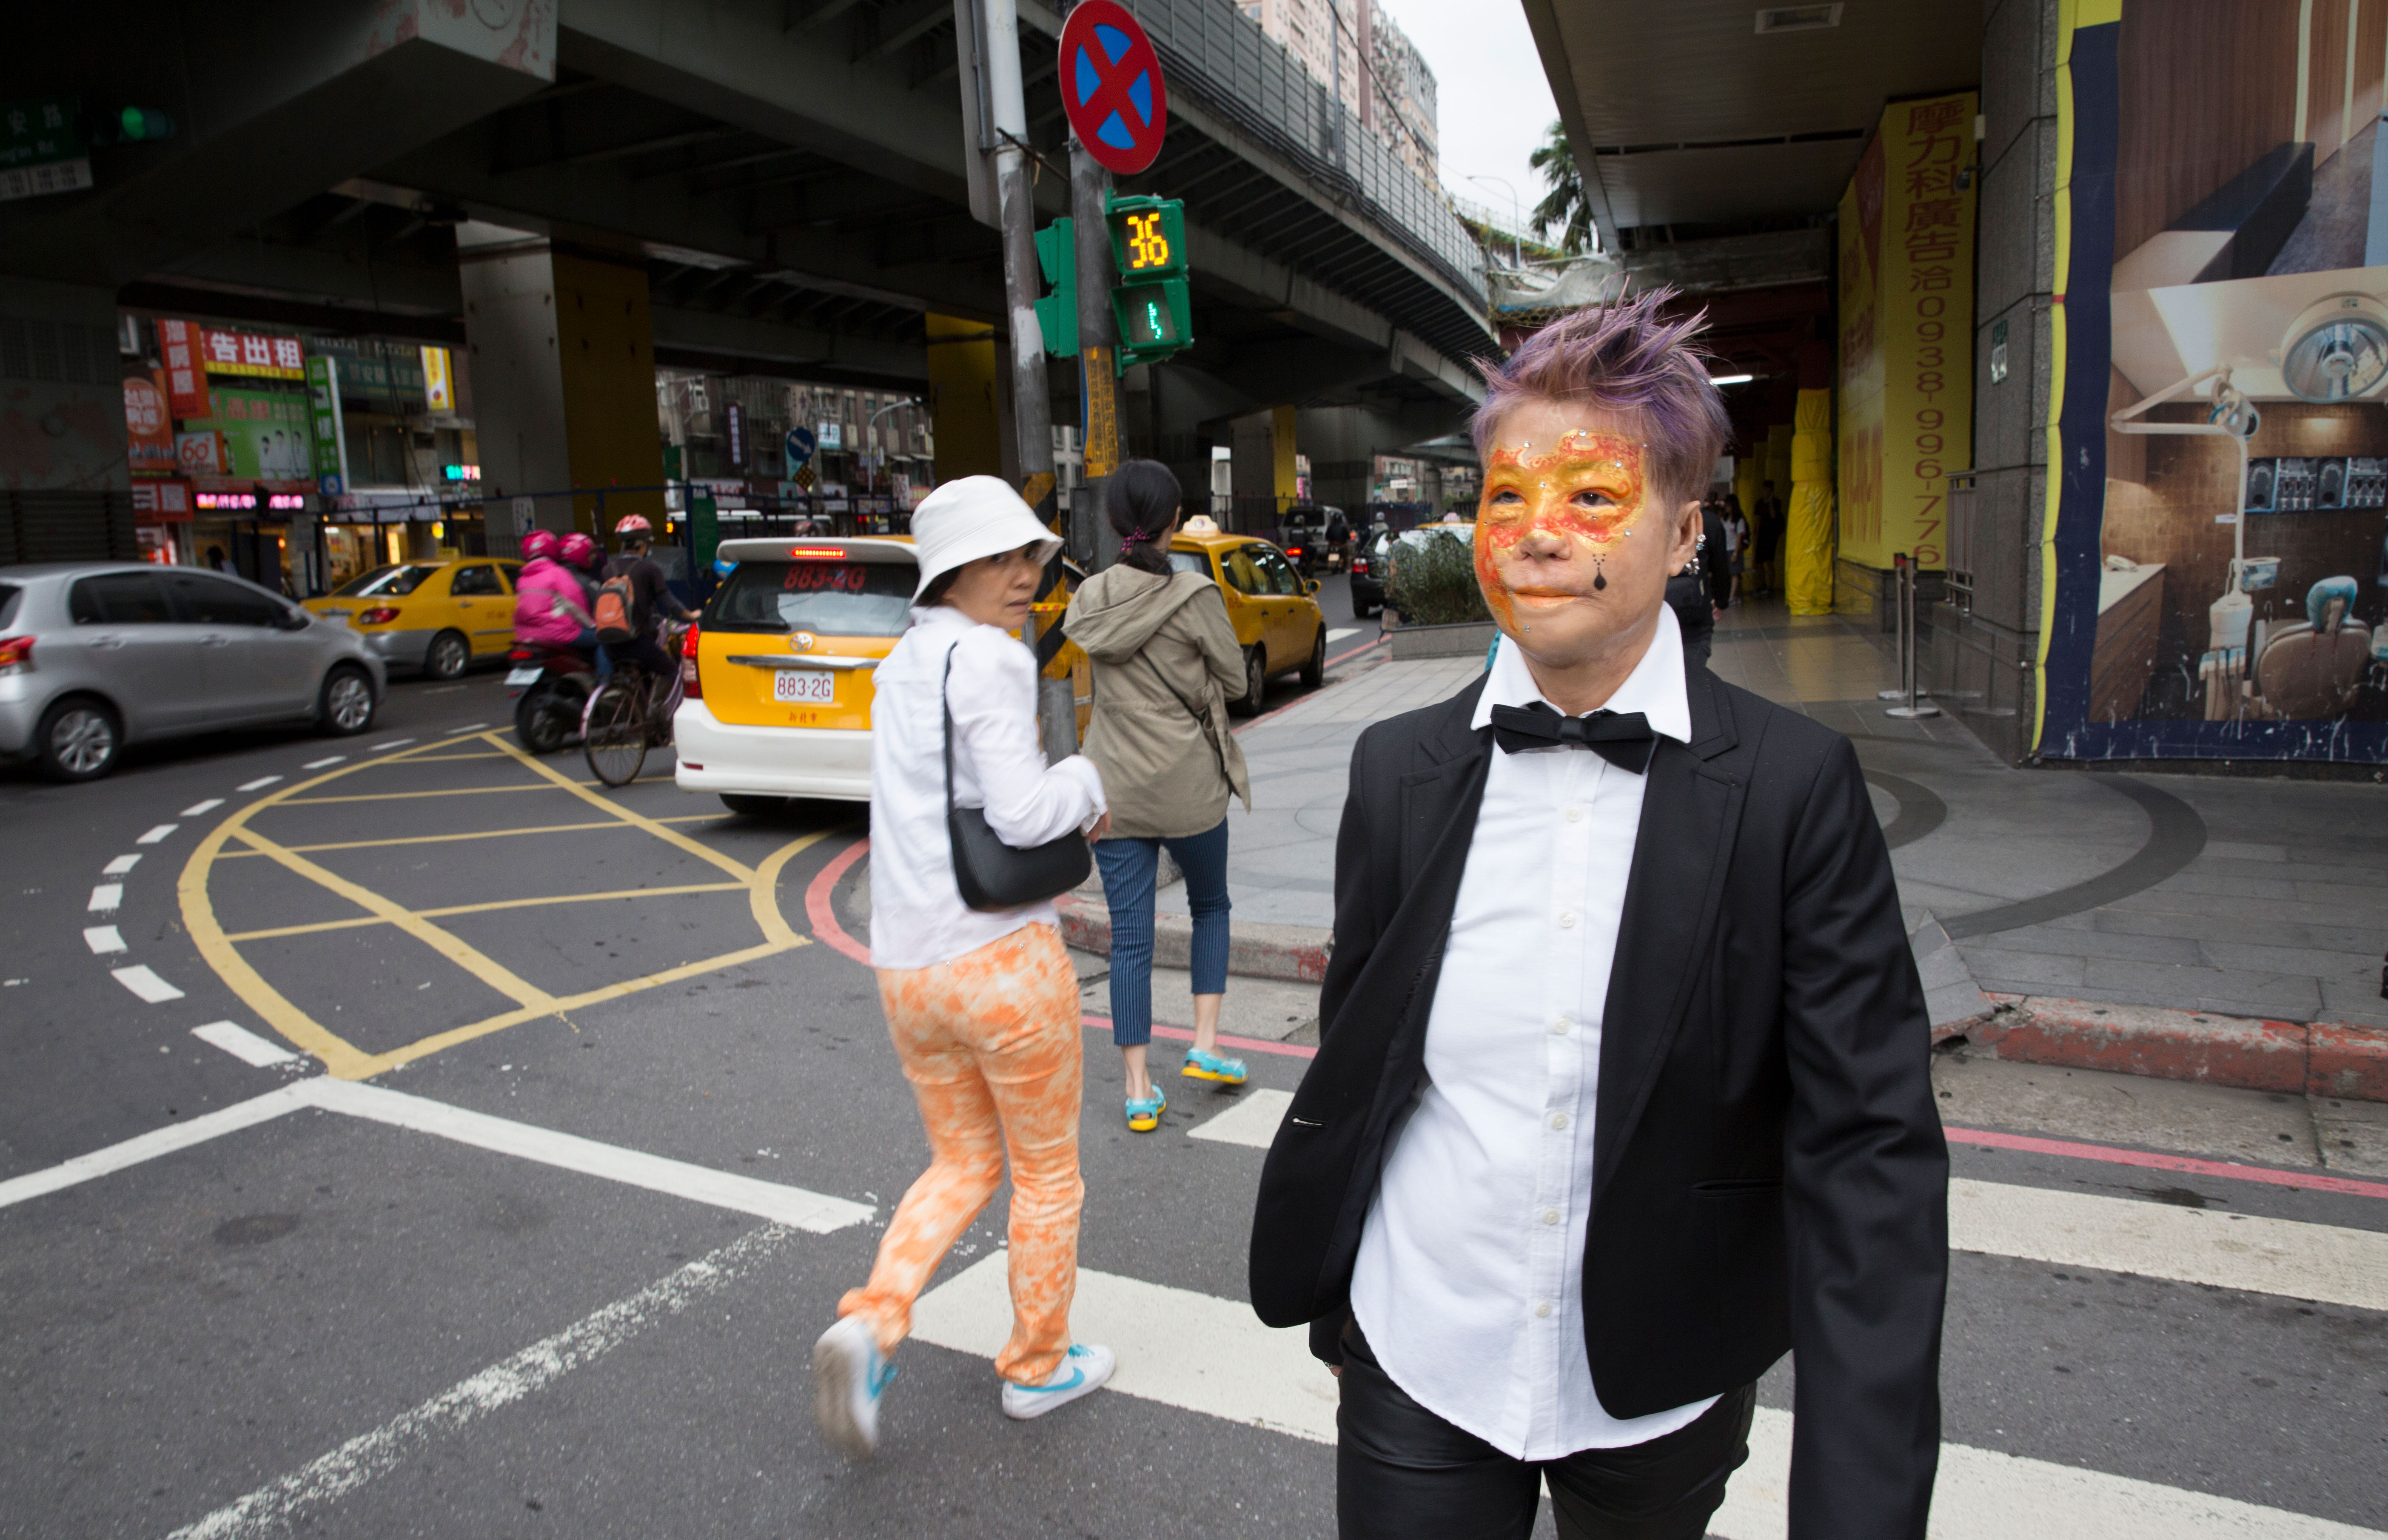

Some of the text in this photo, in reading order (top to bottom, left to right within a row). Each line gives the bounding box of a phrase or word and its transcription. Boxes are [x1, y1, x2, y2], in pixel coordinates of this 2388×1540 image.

[1127, 213, 1169, 268] 36
[200, 331, 303, 369] 告出租
[784, 564, 866, 590] 883-2G
